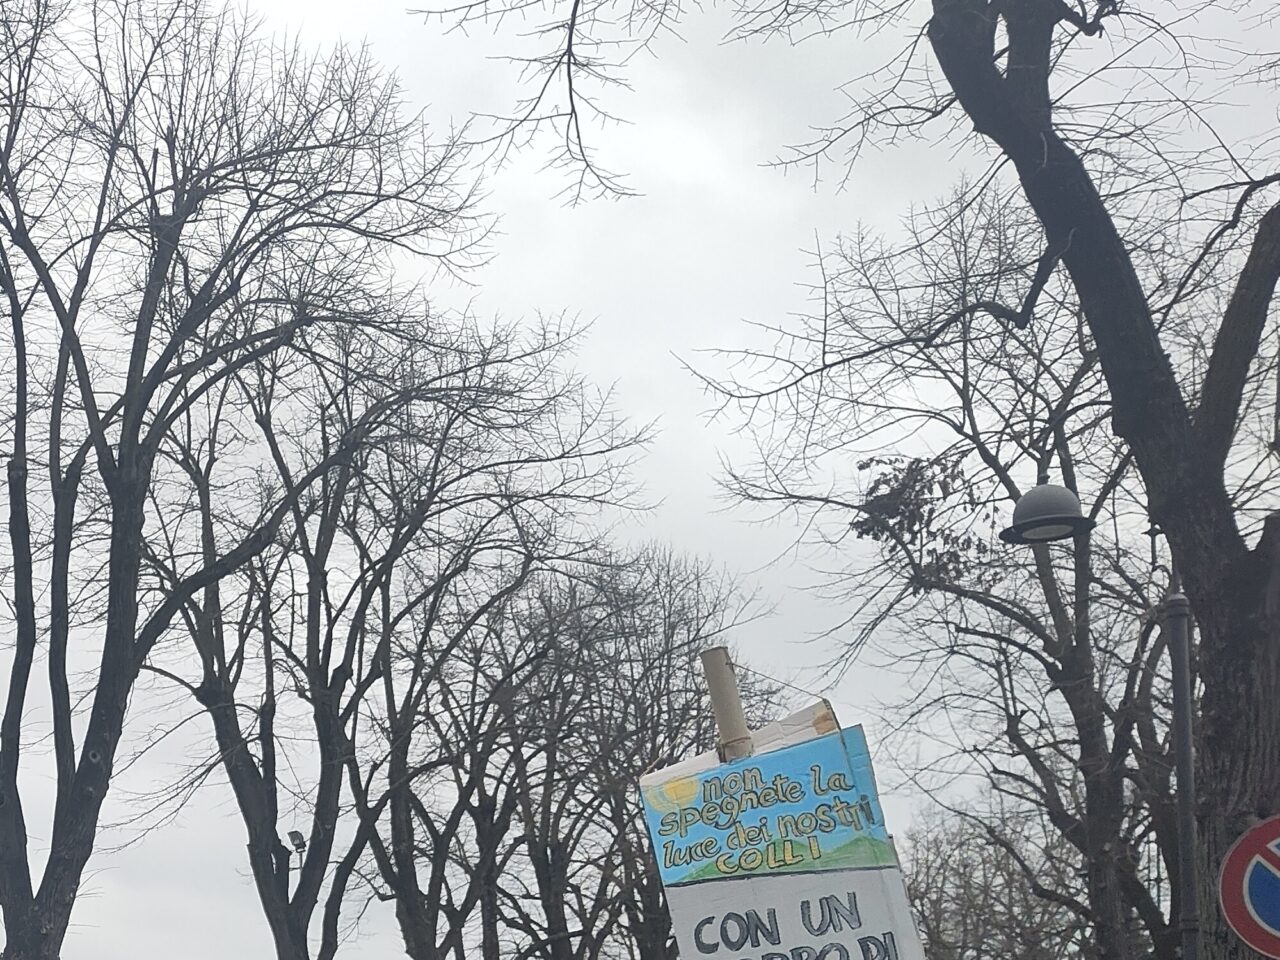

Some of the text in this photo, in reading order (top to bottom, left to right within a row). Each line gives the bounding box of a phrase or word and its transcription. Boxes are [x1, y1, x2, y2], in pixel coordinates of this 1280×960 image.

[658, 764, 855, 838] spegnete la
[703, 767, 765, 803] non
[663, 794, 875, 869] luce dei nostri
[716, 835, 821, 874] COLLI
[694, 891, 862, 954] CON UN
